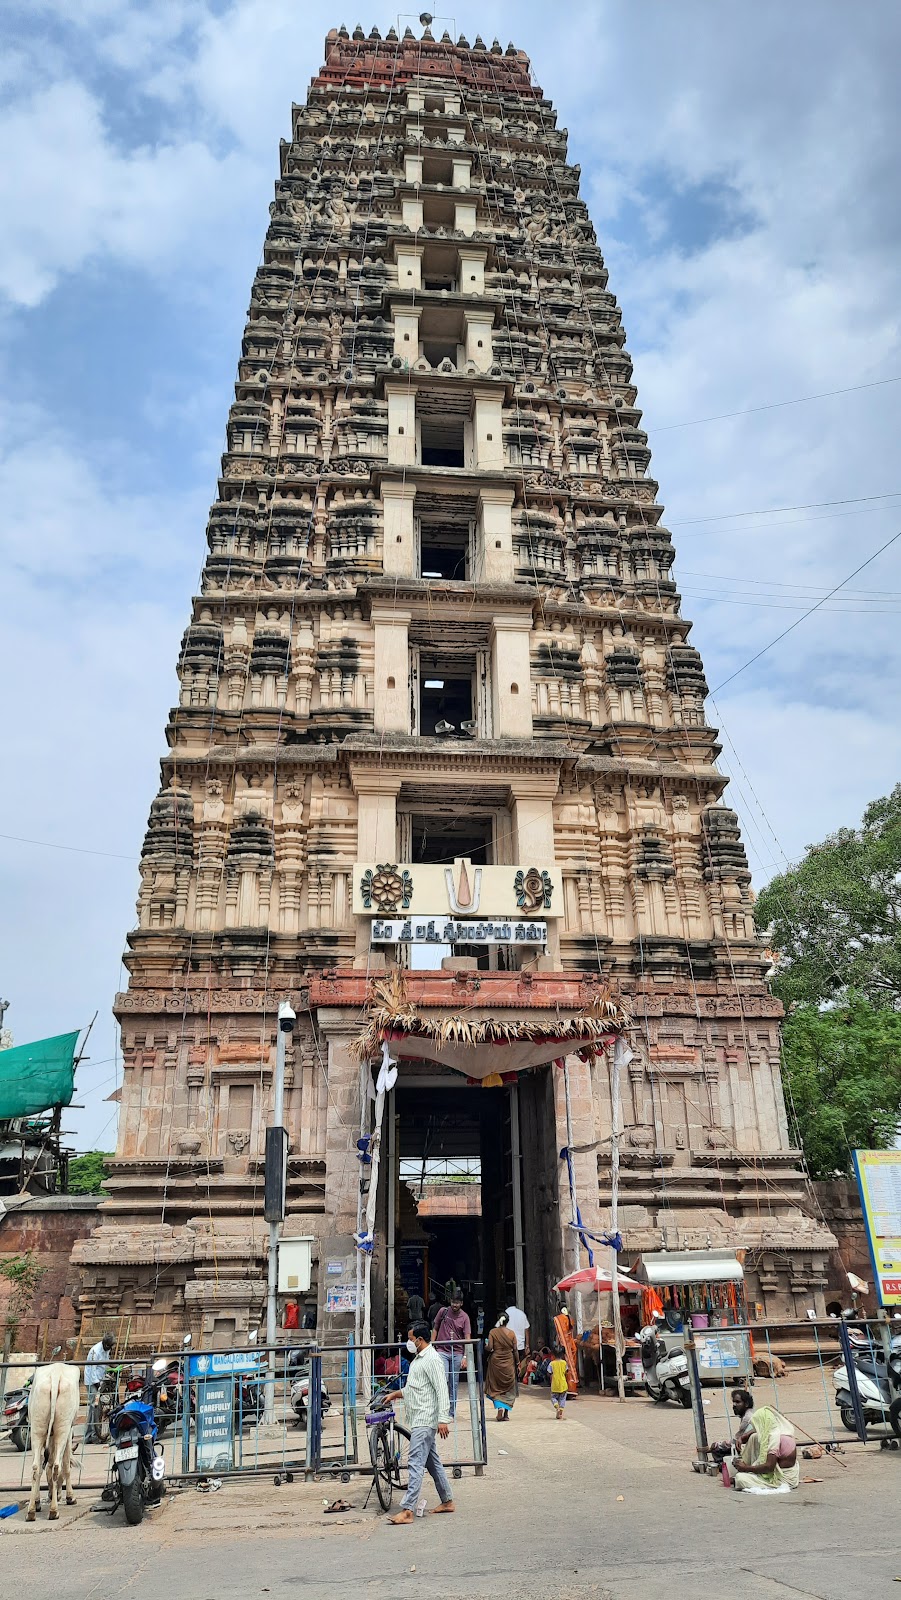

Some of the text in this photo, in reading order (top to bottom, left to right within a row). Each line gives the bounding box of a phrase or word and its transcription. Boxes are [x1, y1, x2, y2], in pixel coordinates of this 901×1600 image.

[373, 921, 392, 939] ఓం
[214, 1354, 244, 1365] MANGALAGIRI
[207, 1391, 224, 1400] DRIVE
[200, 1402, 231, 1413] CAREFULLY
[205, 1415, 226, 1425] TO LIVE
